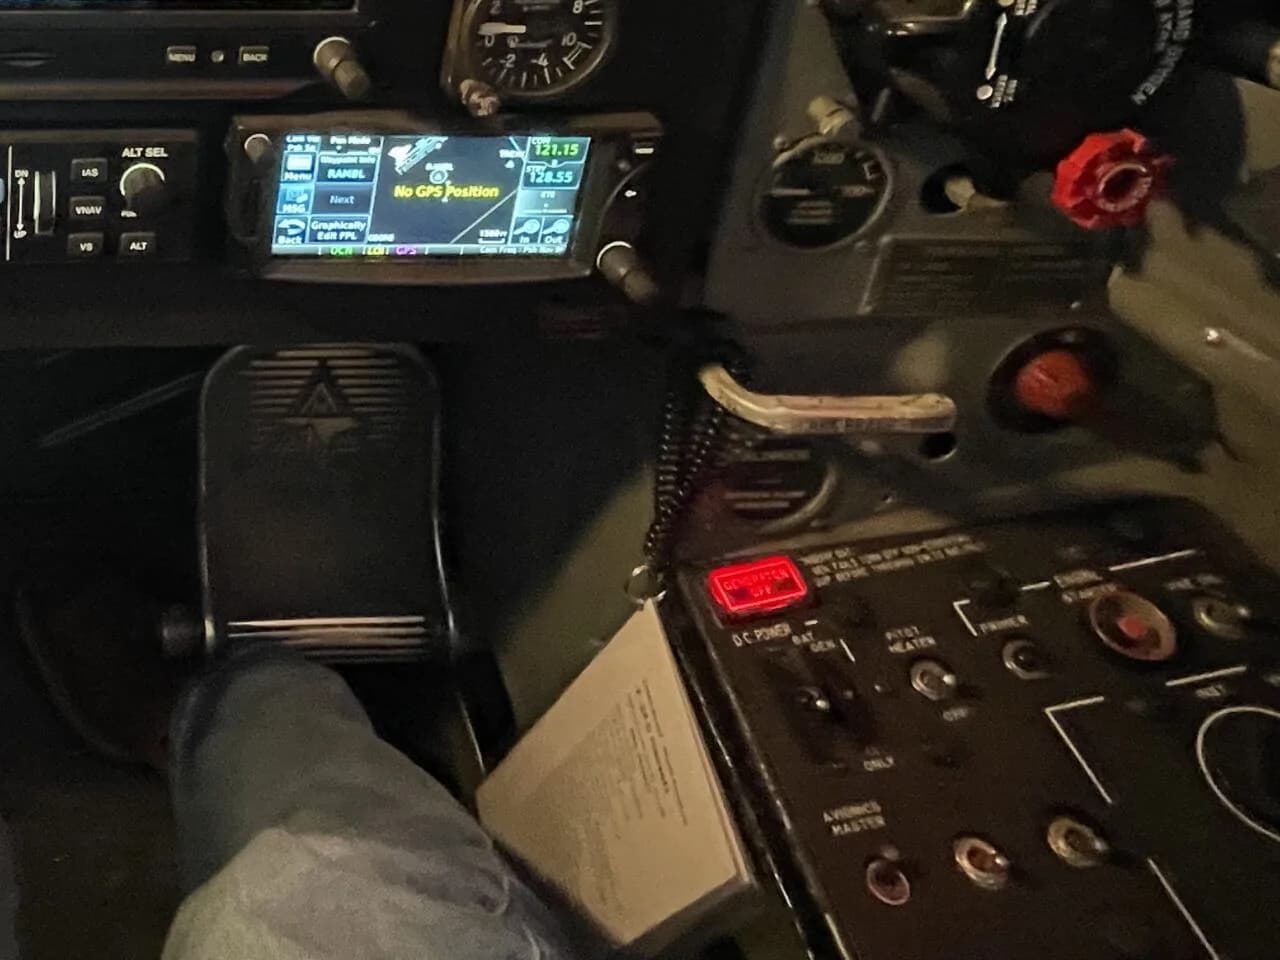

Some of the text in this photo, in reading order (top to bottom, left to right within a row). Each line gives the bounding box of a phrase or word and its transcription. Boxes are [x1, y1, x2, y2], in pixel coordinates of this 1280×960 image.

[572, 0, 583, 14] 8
[562, 32, 576, 46] 10
[122, 148, 168, 157] ALT SEL
[535, 144, 578, 155] 121.15
[15, 170, 29, 178] DN
[82, 168, 98, 177] IAS
[284, 172, 312, 181] Menu
[530, 171, 573, 183] 128.55
[394, 185, 499, 198] No GPS Position
[329, 195, 354, 204] Next
[282, 204, 306, 213] MSG
[311, 221, 367, 232] Graphically
[278, 236, 303, 244] Back
[317, 232, 357, 240] Edit FPL
[80, 243, 93, 251] VS
[130, 242, 147, 251] ALT
[396, 246, 416, 254] GPS
[754, 623, 792, 640] POWER
